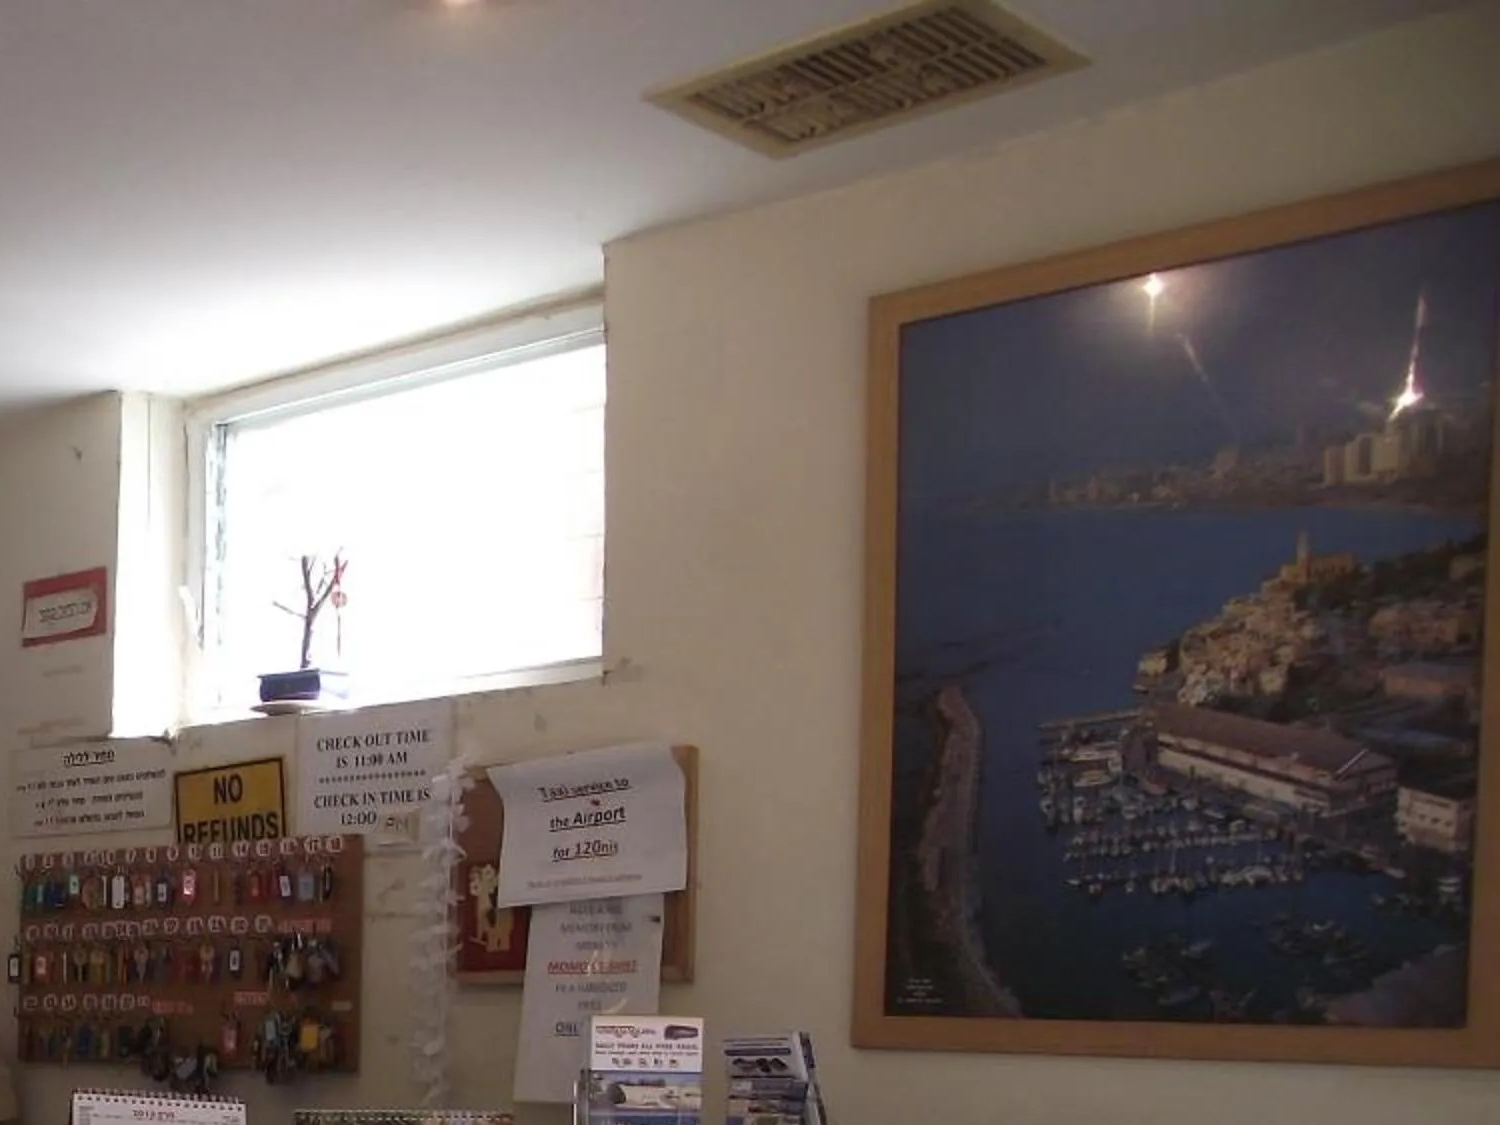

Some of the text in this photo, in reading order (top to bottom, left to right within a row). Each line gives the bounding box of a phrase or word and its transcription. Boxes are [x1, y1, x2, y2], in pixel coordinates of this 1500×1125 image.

[316, 729, 430, 751] CHECK OUT TIME
[336, 755, 348, 768] IS
[387, 751, 407, 765] AM
[213, 773, 243, 806] NO
[314, 787, 430, 808] CHECK IN TIME IS
[537, 776, 631, 801] Taxi service to
[182, 810, 280, 844] REFUNDS
[549, 805, 627, 831] the Airport
[553, 844, 570, 860] for
